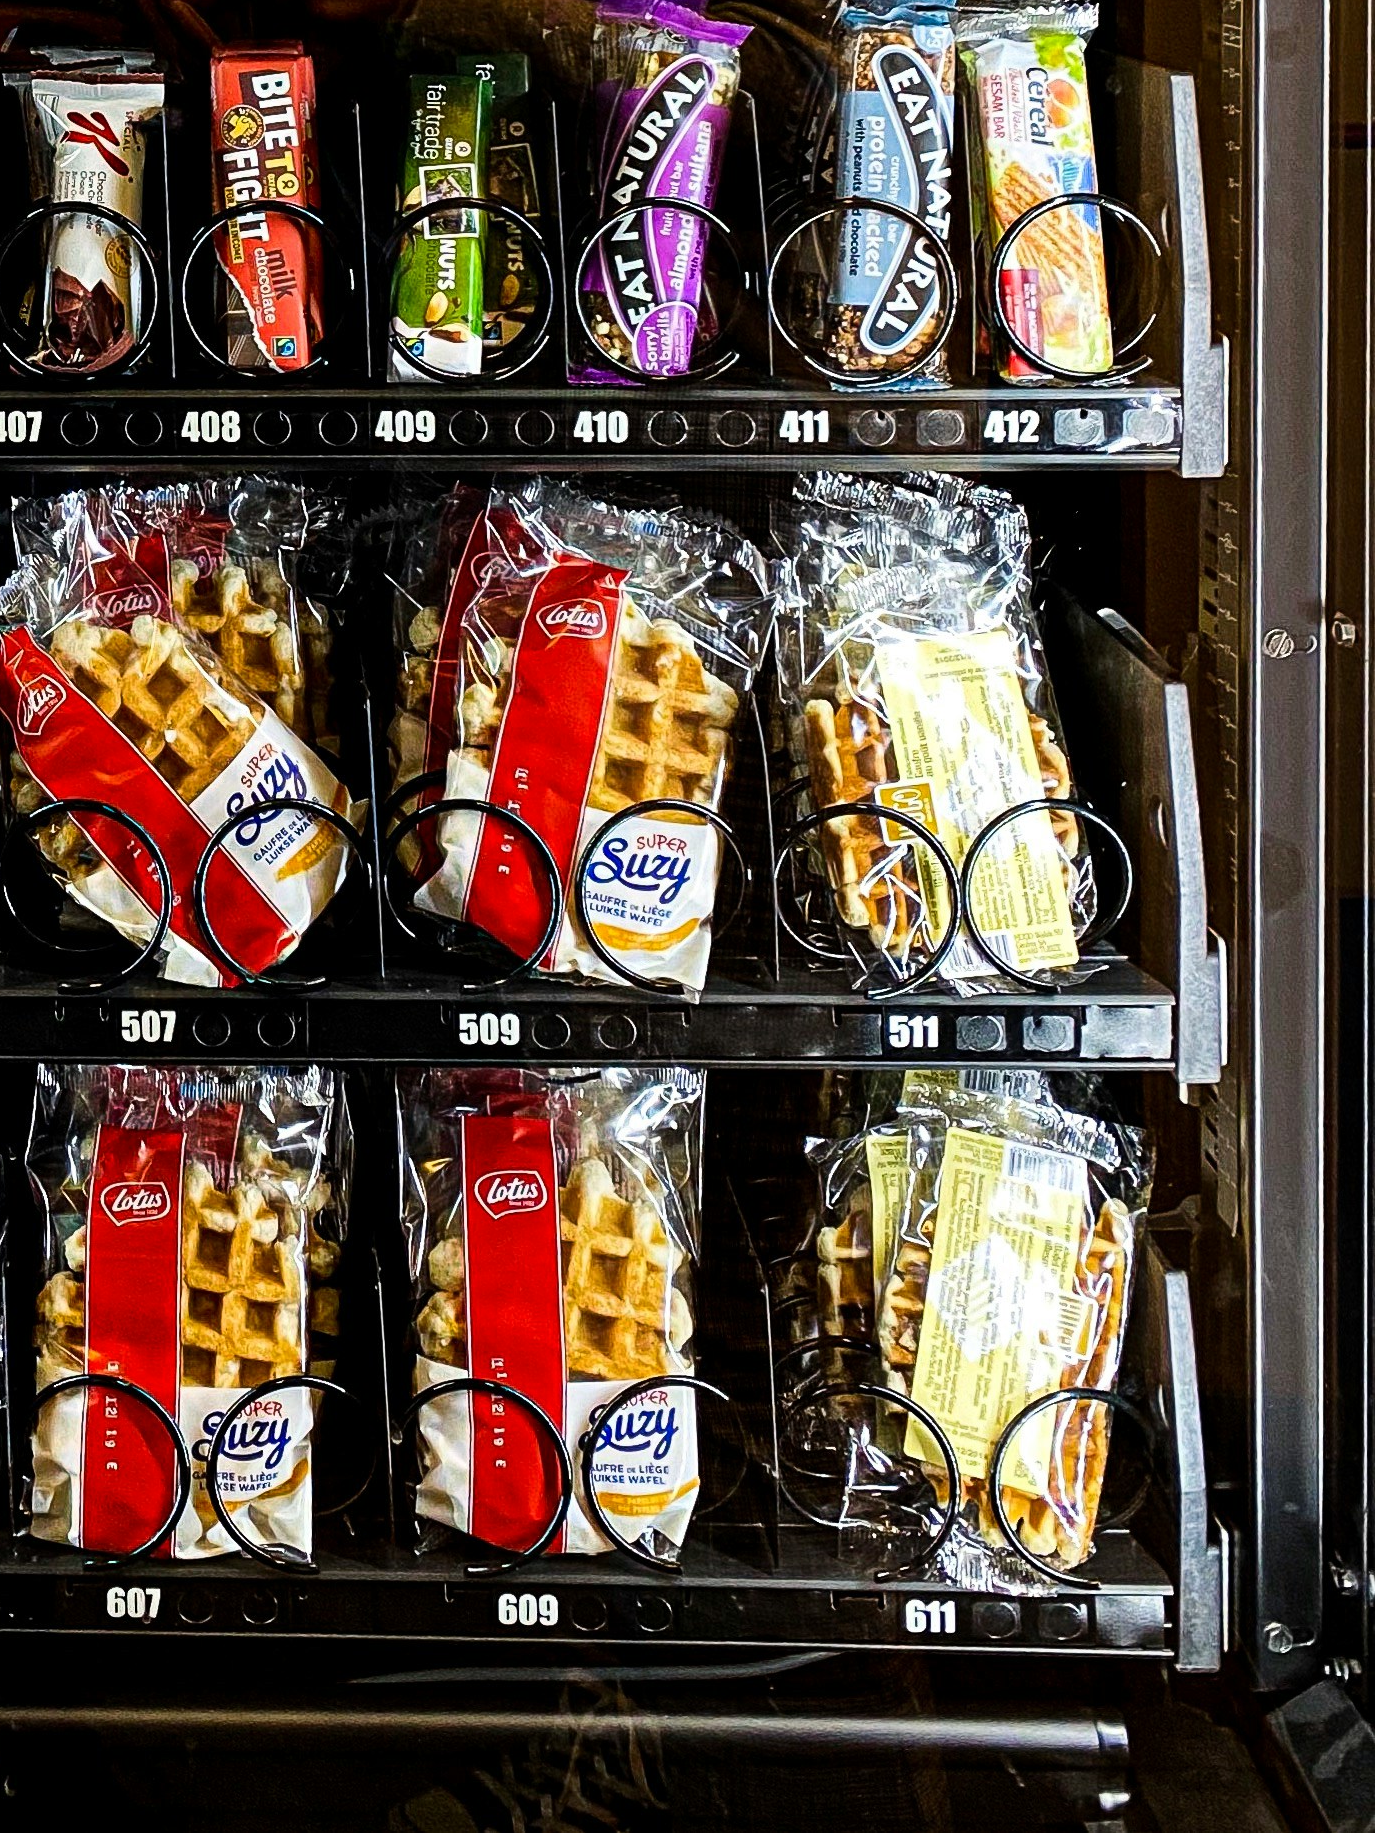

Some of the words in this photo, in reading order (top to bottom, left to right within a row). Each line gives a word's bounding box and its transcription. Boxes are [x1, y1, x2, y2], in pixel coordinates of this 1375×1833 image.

[251, 71, 300, 150] BITE
[887, 66, 943, 138] EAT
[989, 74, 1003, 116] SESAM
[424, 83, 447, 161] fairtrade
[991, 116, 1006, 140] BAR
[610, 71, 707, 242] NATURAL
[851, 145, 865, 193] peanuts
[865, 114, 888, 194] protein
[888, 155, 902, 203] crunchy
[668, 212, 695, 292] almond
[686, 119, 713, 193] sultana
[848, 218, 862, 278] chocolate
[875, 147, 954, 335] NATURAL
[265, 247, 298, 302] milk
[437, 238, 457, 292] NUTS
[253, 246, 277, 326] chocolate
[623, 252, 656, 325] EAT
[181, 410, 241, 443] 408
[375, 411, 436, 443] 409
[573, 408, 629, 443] 410
[778, 409, 829, 443] 411
[982, 408, 1038, 443] 412
[544, 603, 601, 629] lotus
[240, 743, 279, 790] SUPER
[226, 749, 308, 848] Suzy
[252, 827, 290, 864] GAUFRE
[264, 831, 296, 866] LUIKSE
[636, 833, 688, 857] SUPER
[586, 837, 691, 905] Suzy
[589, 903, 628, 920] LUIKSE
[641, 901, 673, 919] LIÈGE
[121, 1010, 177, 1043] 507
[458, 1014, 521, 1046] 509
[889, 1015, 939, 1048] 511
[119, 1185, 168, 1213] lotus
[484, 1176, 545, 1202] lotus
[202, 1411, 292, 1468] Suzy
[589, 1409, 686, 1461] Suzy
[107, 1587, 162, 1619] 607
[499, 1594, 560, 1627] 609
[906, 1600, 957, 1635] 611
